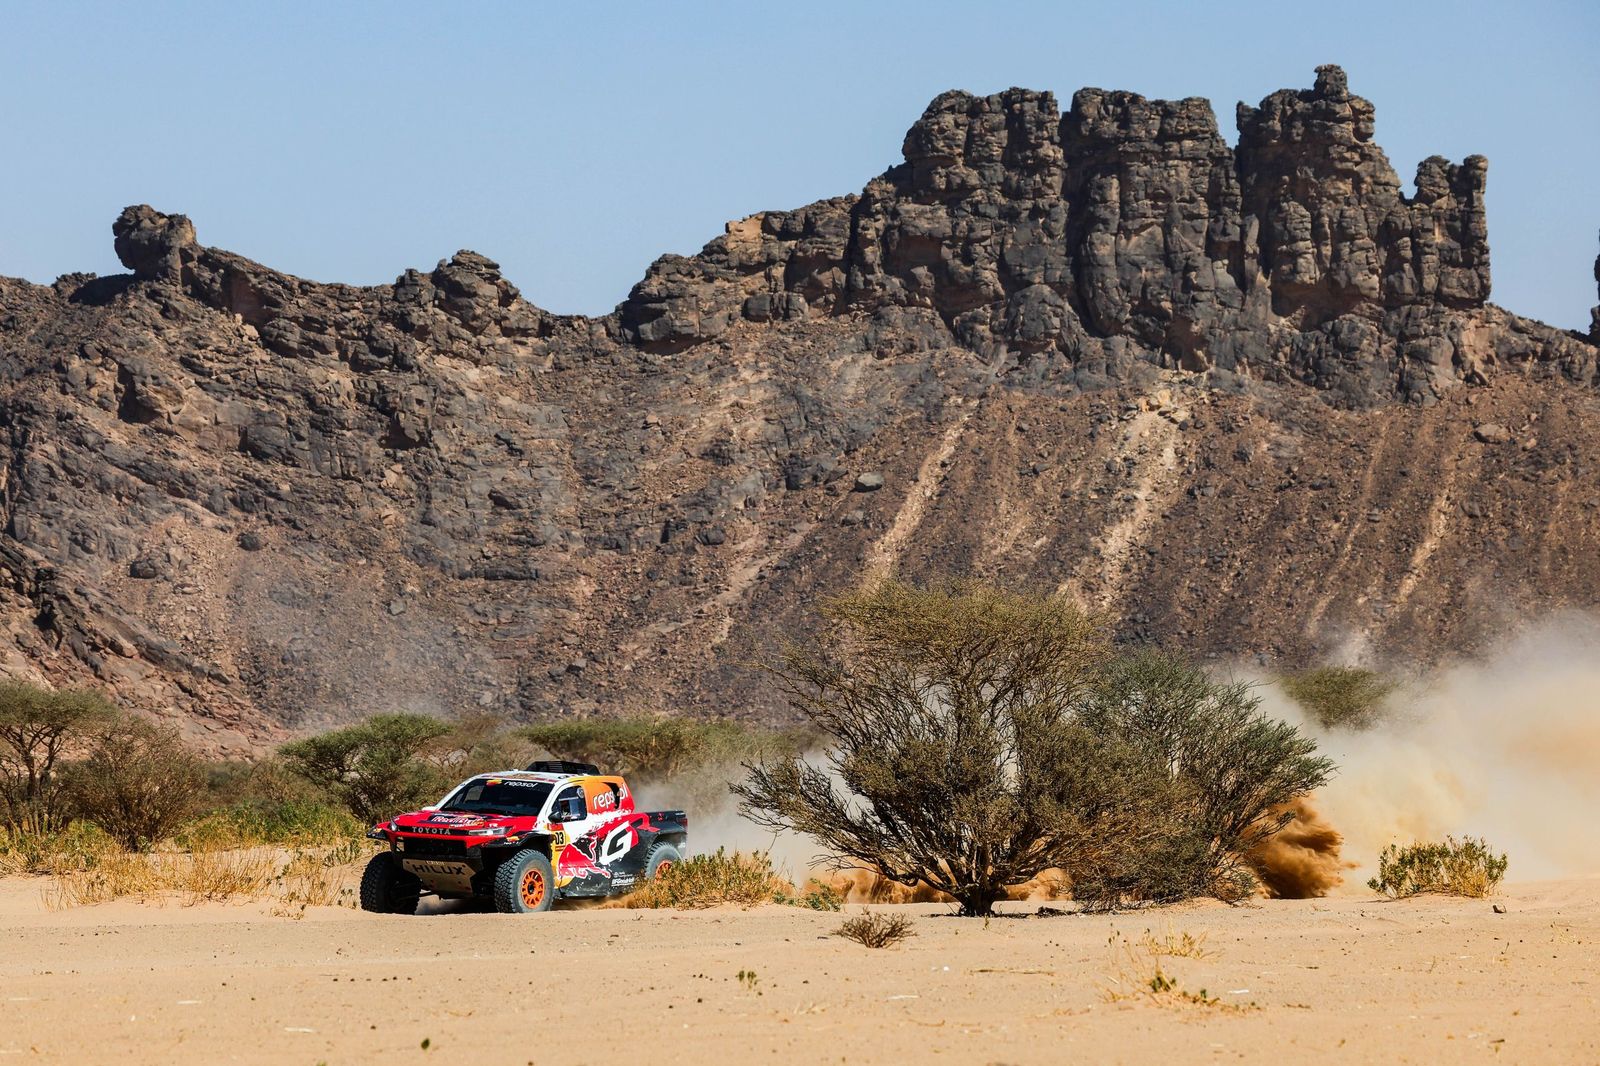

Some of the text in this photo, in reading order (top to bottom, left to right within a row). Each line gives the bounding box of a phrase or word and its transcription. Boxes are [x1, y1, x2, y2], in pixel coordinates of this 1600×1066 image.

[593, 782, 628, 809] repsol
[412, 826, 451, 835] TOYOTA
[412, 864, 465, 875] HILUX
